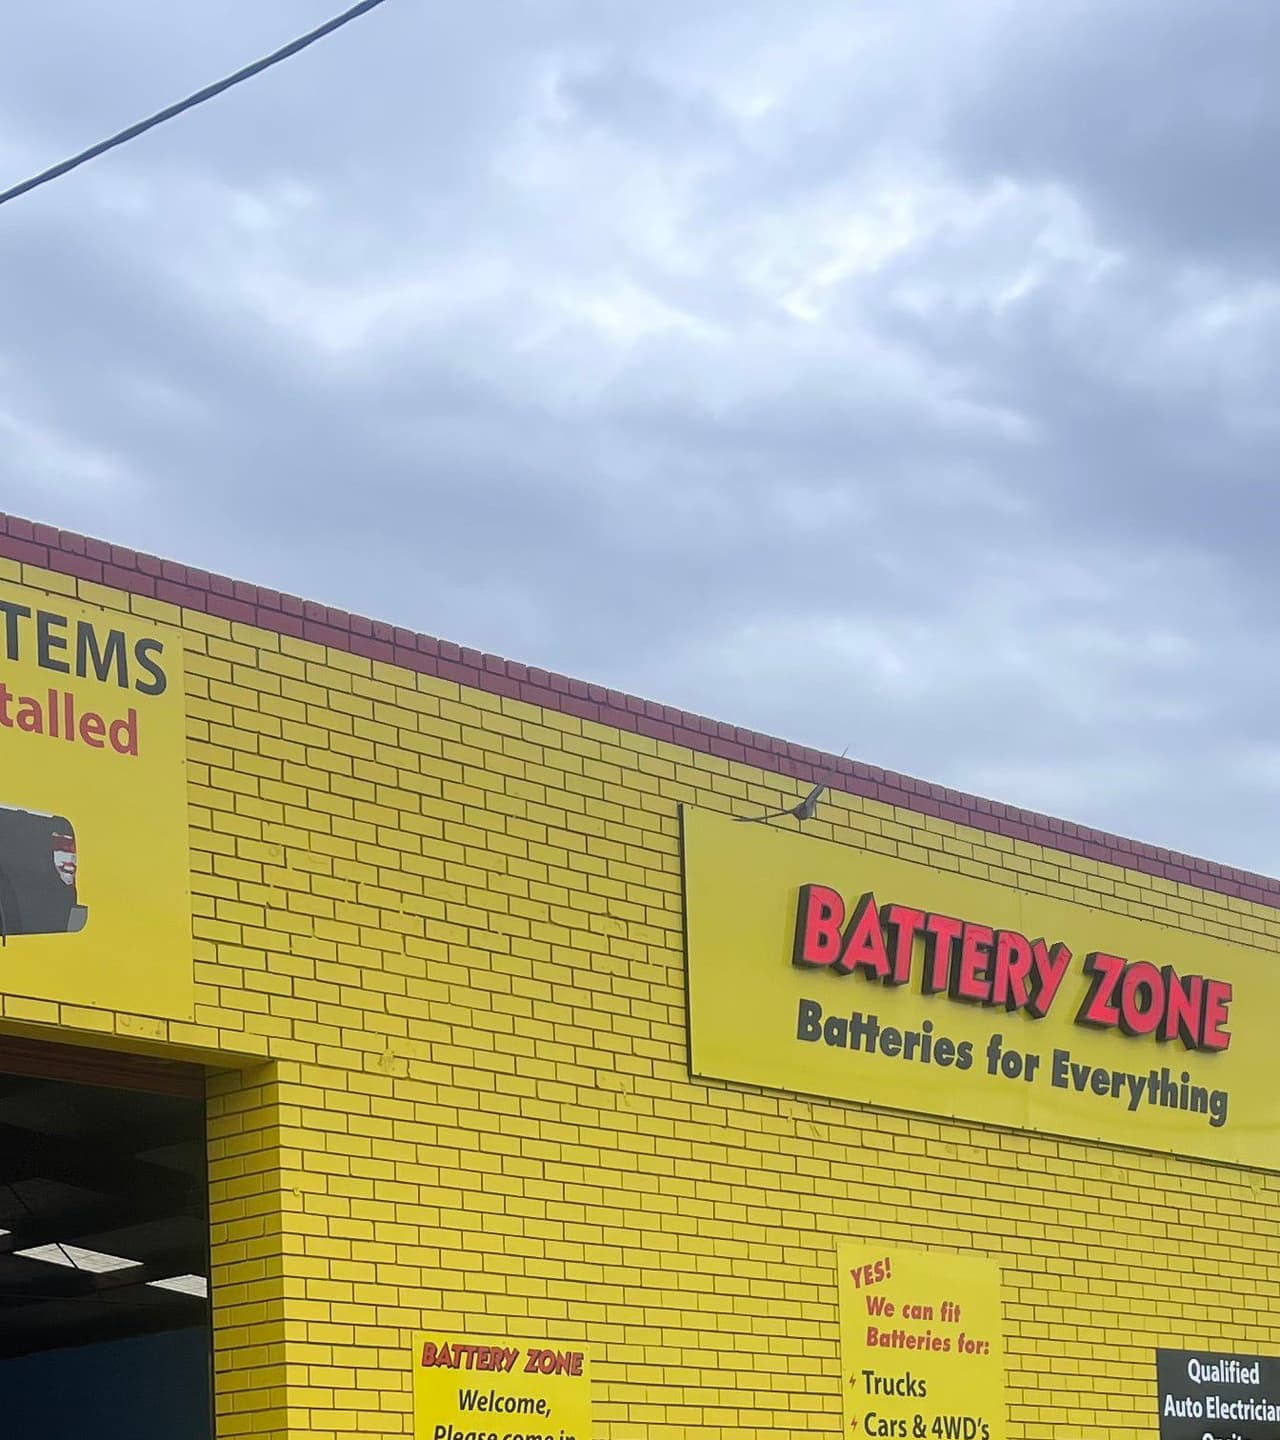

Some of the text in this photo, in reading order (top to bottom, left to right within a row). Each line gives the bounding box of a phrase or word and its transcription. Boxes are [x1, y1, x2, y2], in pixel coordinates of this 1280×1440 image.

[792, 883, 1233, 1053] BATTERY ZONE
[797, 999, 1229, 1128] Batteries for Everything
[850, 1257, 892, 1289] YES!
[866, 1295, 961, 1323] We can fit
[866, 1326, 990, 1355] Batteries for:
[421, 1341, 584, 1376] BATTERY ZONE
[1187, 1358, 1260, 1385] Qualified
[861, 1369, 927, 1398] Trucks
[458, 1388, 552, 1418] Welcome,
[1164, 1394, 1203, 1418] Auto
[864, 1412, 990, 1440] Cars & 4WD's
